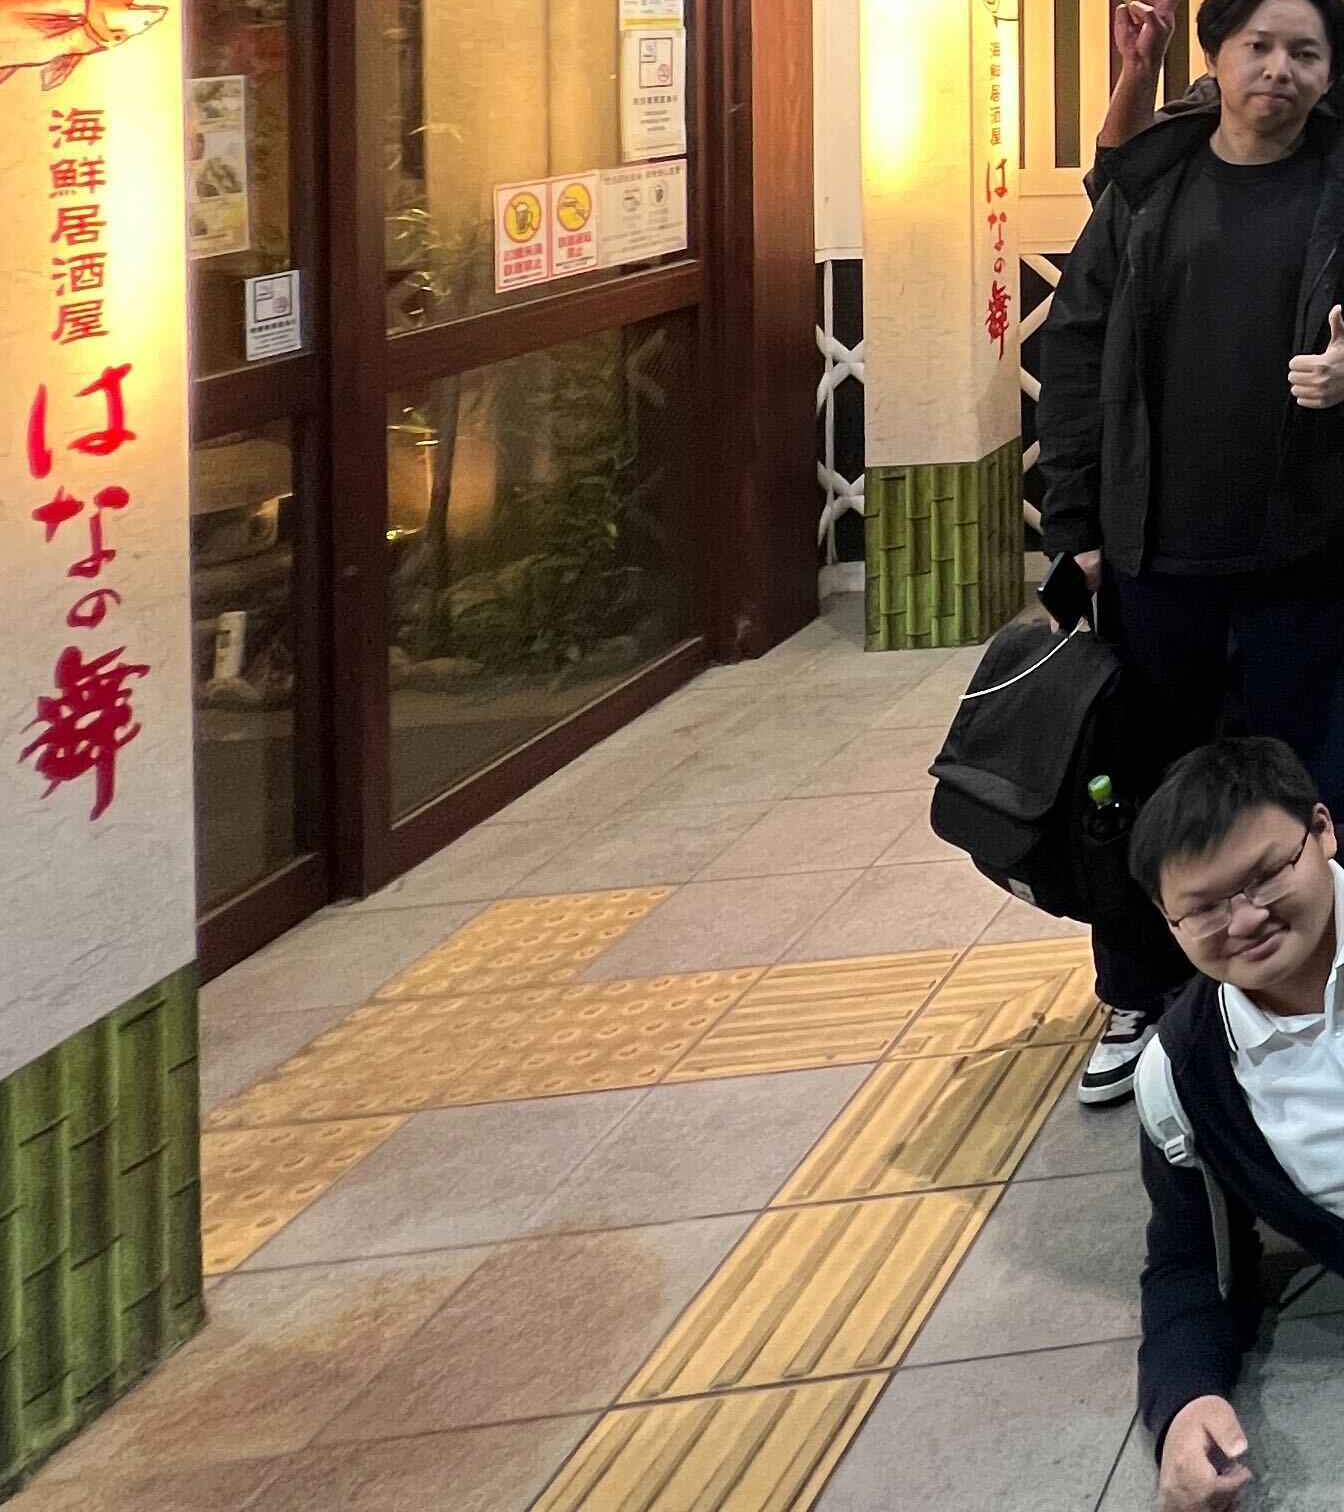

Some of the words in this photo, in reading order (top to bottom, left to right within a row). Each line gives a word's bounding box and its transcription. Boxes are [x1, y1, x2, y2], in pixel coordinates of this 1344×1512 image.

[49, 107, 109, 346] 海鮮居酒屋
[985, 157, 1010, 361] はなの舞
[17, 361, 151, 822] はなの舞
